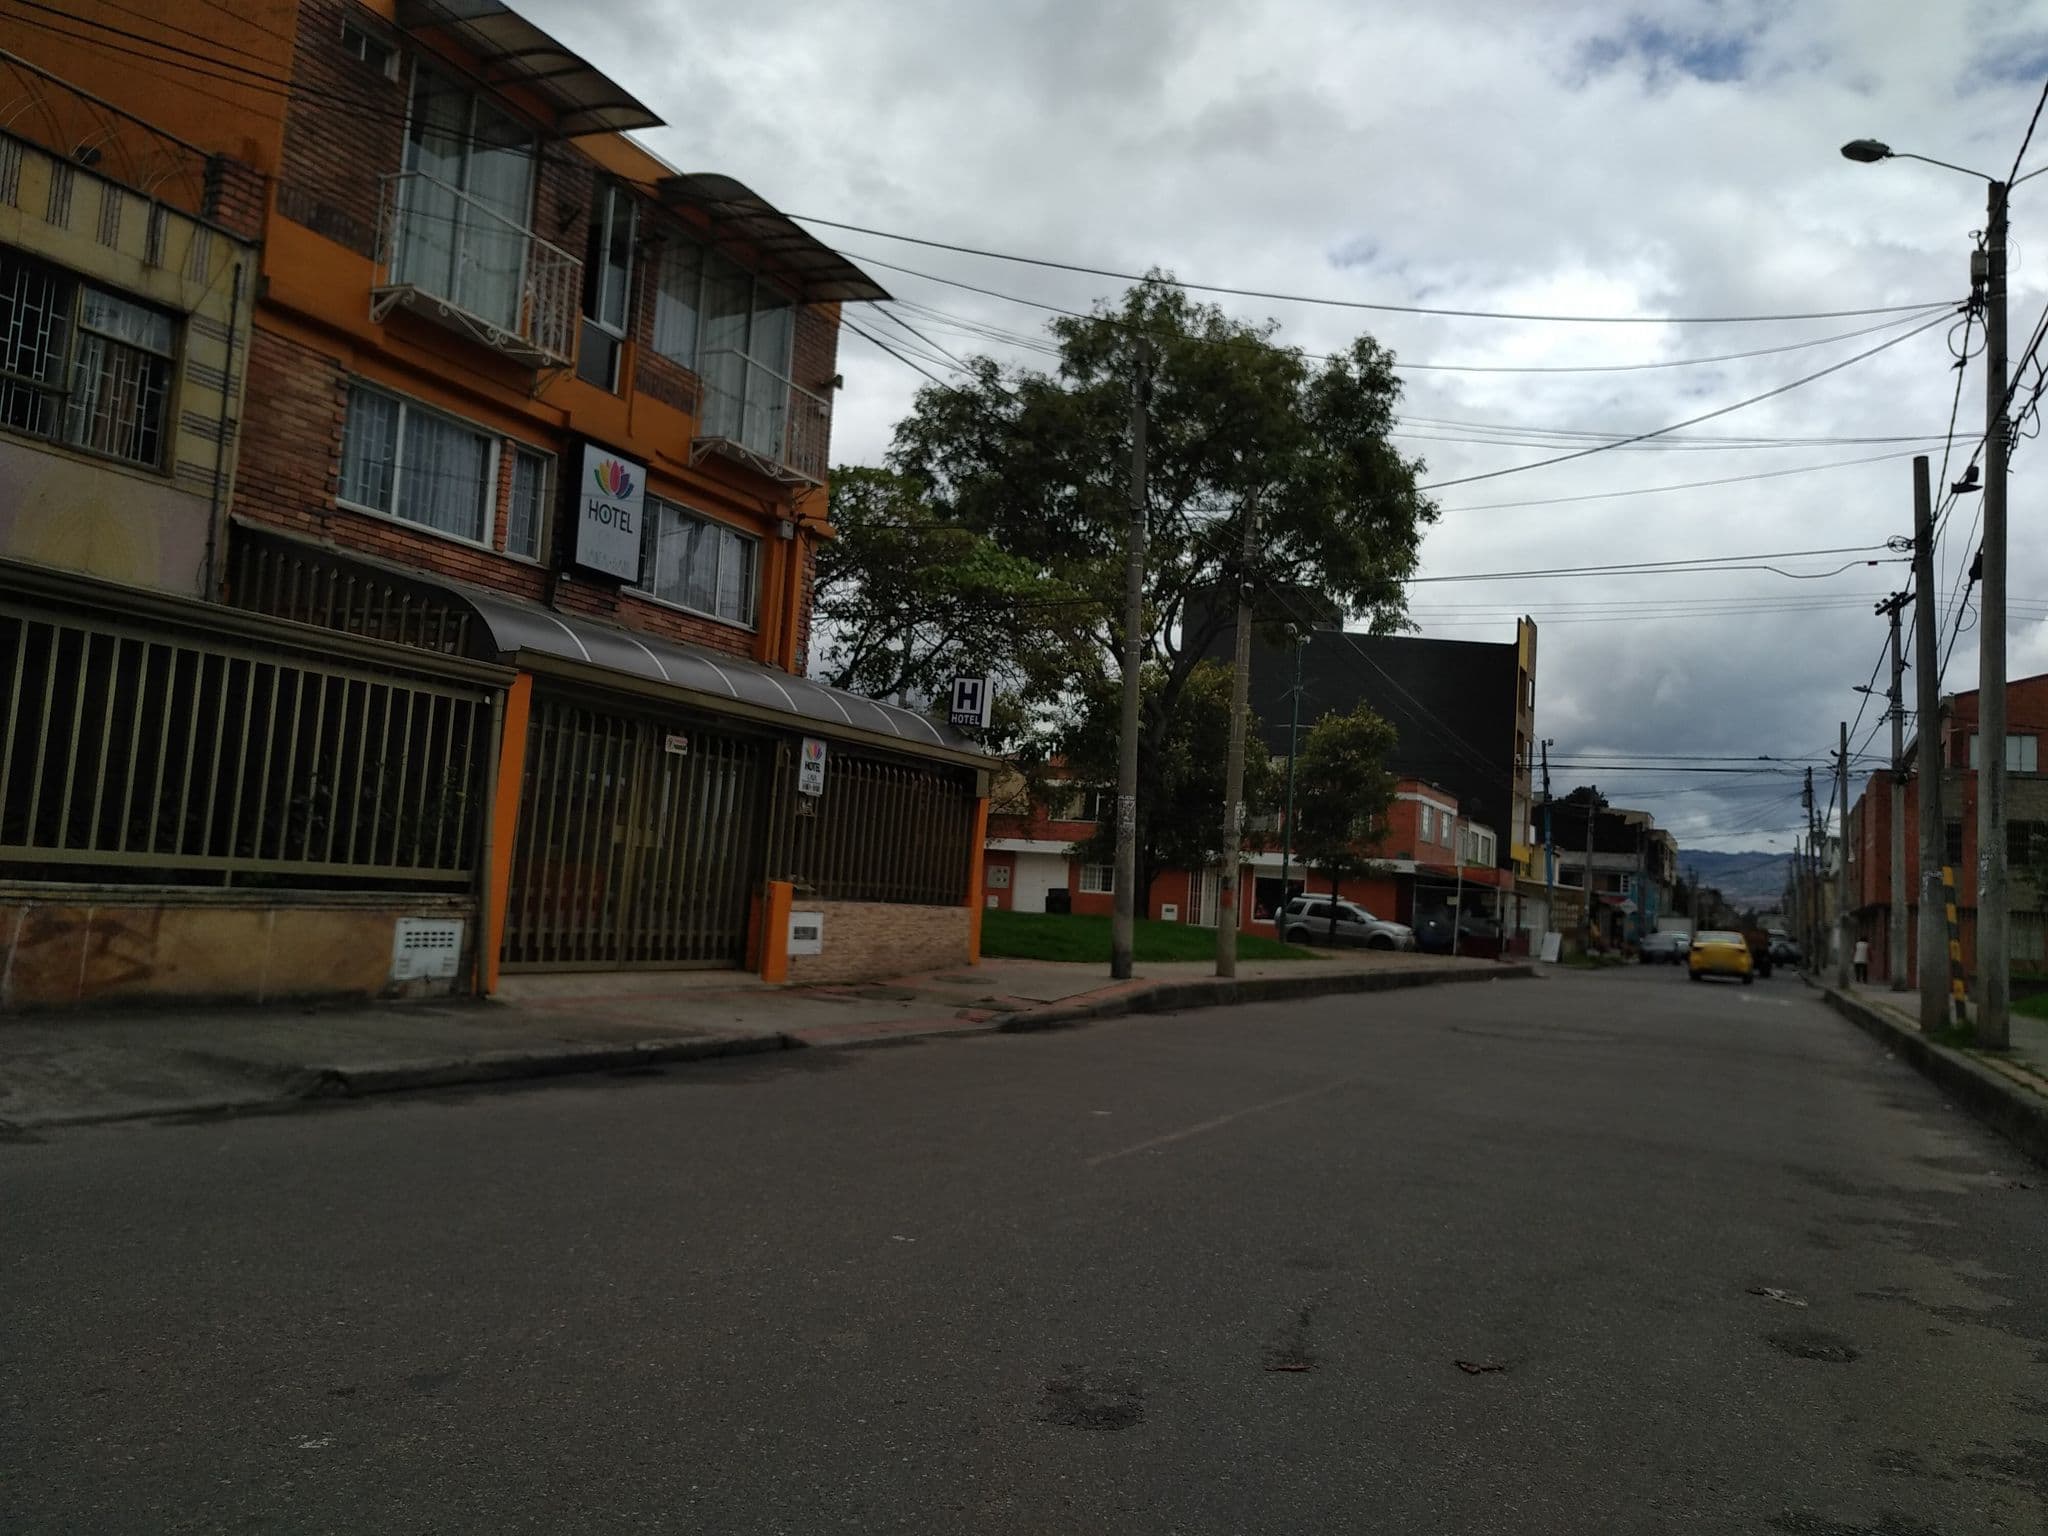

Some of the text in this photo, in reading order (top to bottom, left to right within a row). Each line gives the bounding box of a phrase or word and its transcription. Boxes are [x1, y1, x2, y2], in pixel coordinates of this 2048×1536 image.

[588, 499, 633, 534] HOTEL
[957, 682, 978, 710] H
[951, 713, 980, 725] HOTEL
